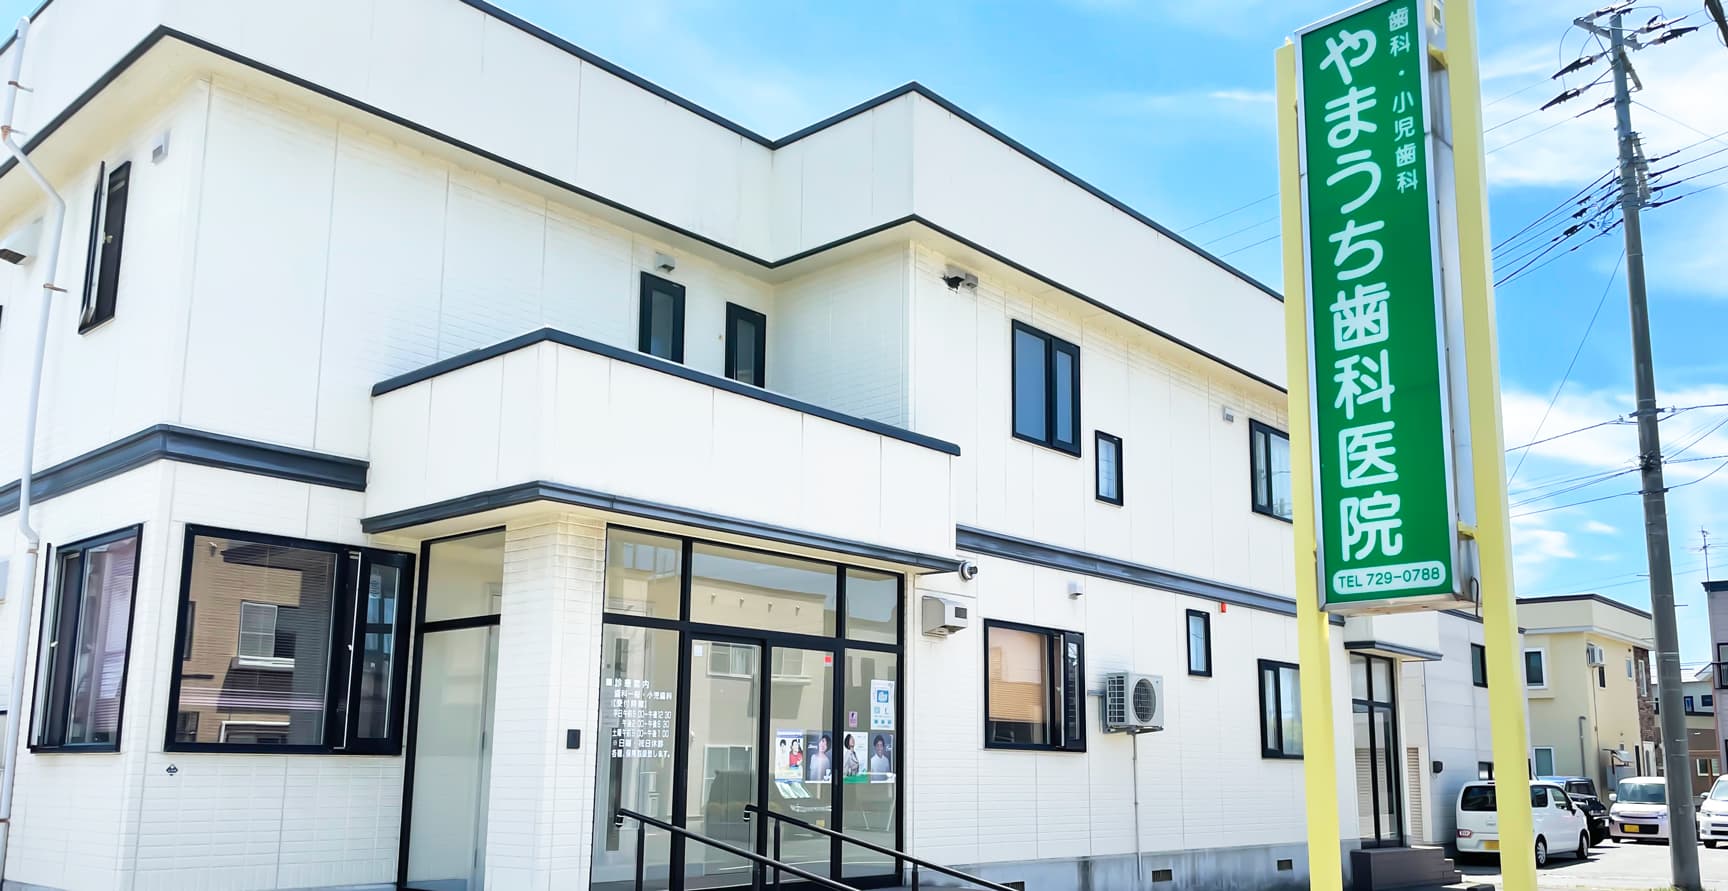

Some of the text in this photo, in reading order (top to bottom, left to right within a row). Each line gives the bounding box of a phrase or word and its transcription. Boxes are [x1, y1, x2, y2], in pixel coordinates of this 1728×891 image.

[1387, 6, 1419, 193] 歯科・小児歯科
[1320, 29, 1404, 562] やまうち歯科医院
[1338, 567, 1440, 589] TEL 729-0788
